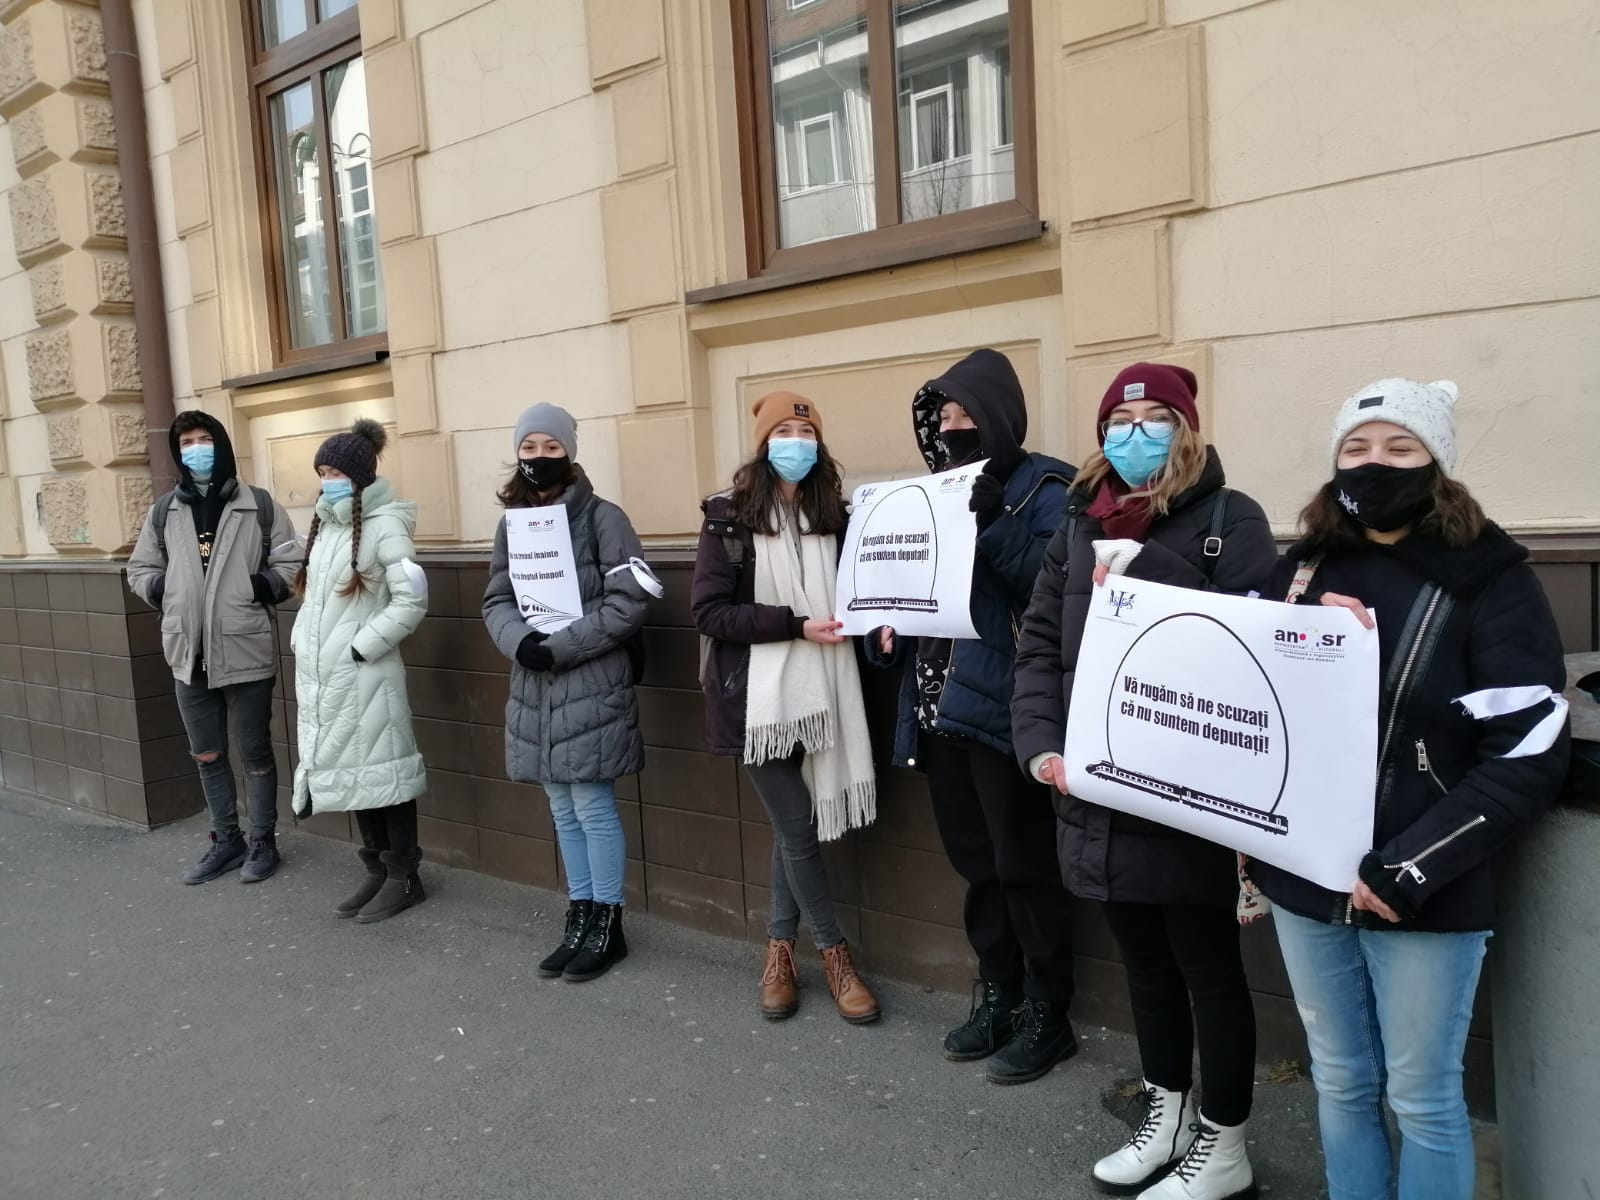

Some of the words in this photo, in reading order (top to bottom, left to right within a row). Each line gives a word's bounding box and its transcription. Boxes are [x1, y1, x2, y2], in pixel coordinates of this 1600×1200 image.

[872, 549, 897, 561] suntem
[895, 534, 904, 544] ne
[1124, 675, 1138, 695] Vă
[1140, 683, 1177, 706] rugăm
[1180, 691, 1194, 710] să
[1197, 697, 1214, 715] ne
[1217, 702, 1269, 732] scuzați
[1120, 699, 1135, 717] că
[1136, 705, 1152, 722] nu
[1154, 710, 1199, 736] suntem
[1202, 722, 1269, 756] deputați!
